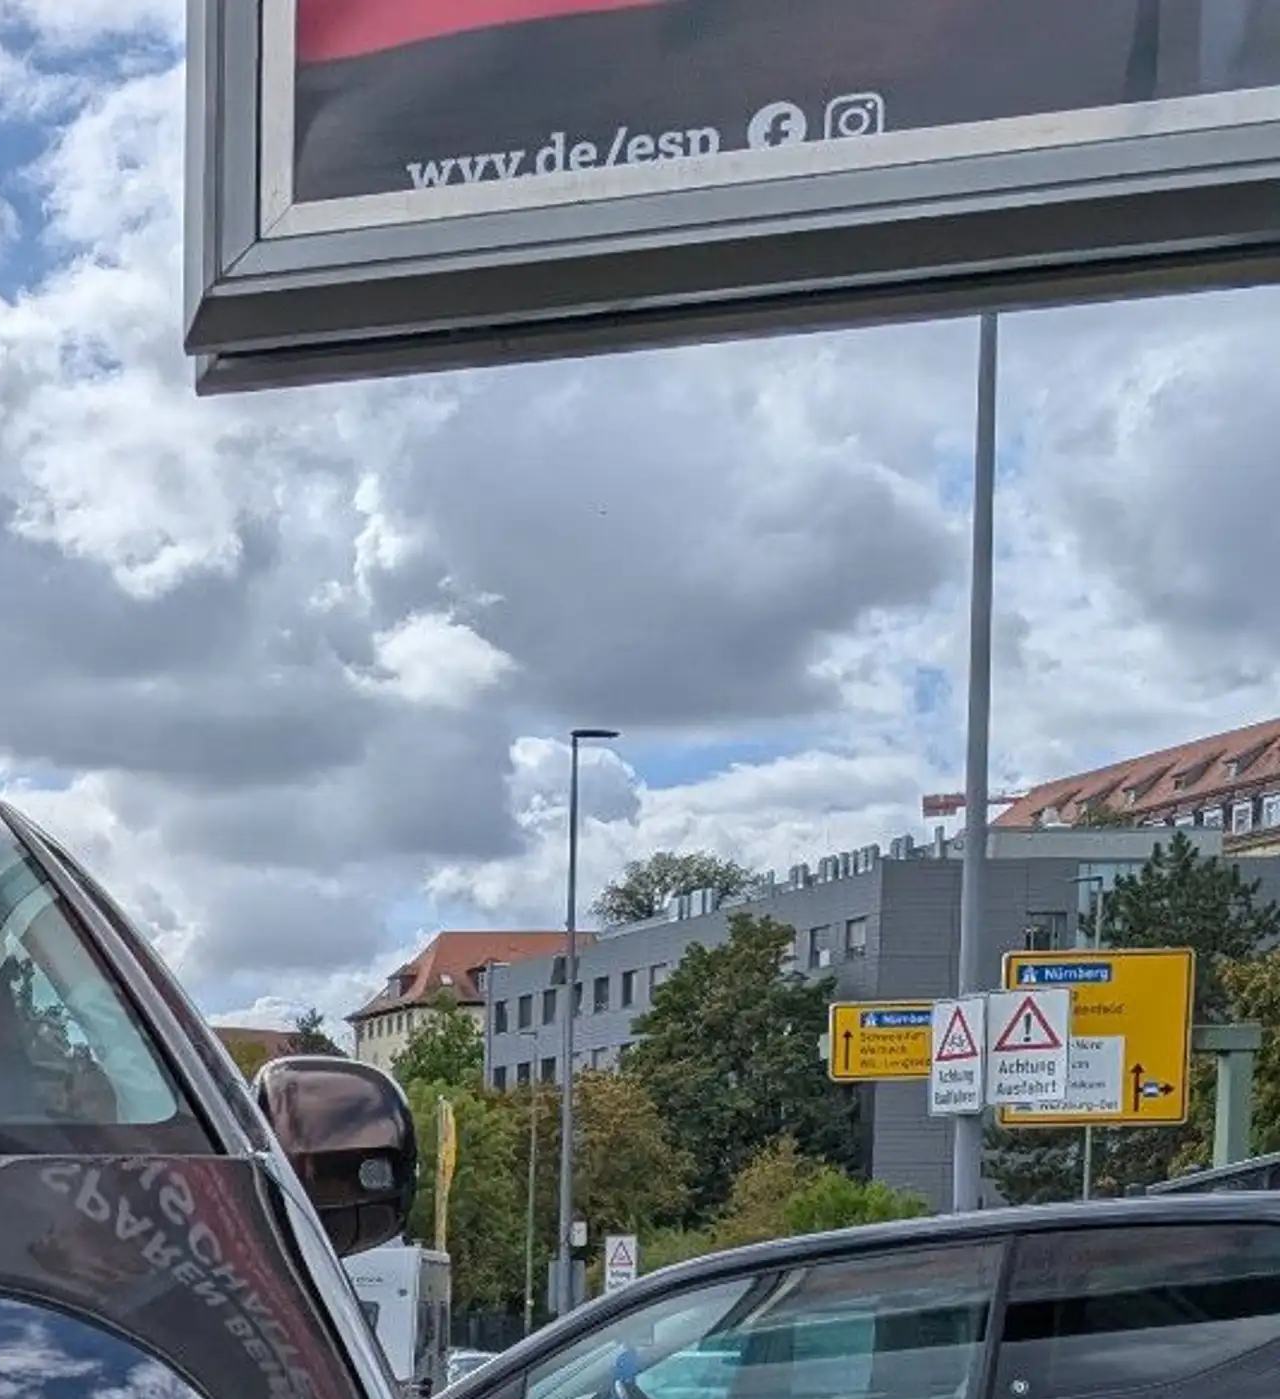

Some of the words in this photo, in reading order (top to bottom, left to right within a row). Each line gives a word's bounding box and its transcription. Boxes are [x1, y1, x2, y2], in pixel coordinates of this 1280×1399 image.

[1044, 967, 1109, 982] Nürnberg
[998, 1058, 1056, 1076] Achtung
[996, 1080, 1057, 1096] Ausfahrt
